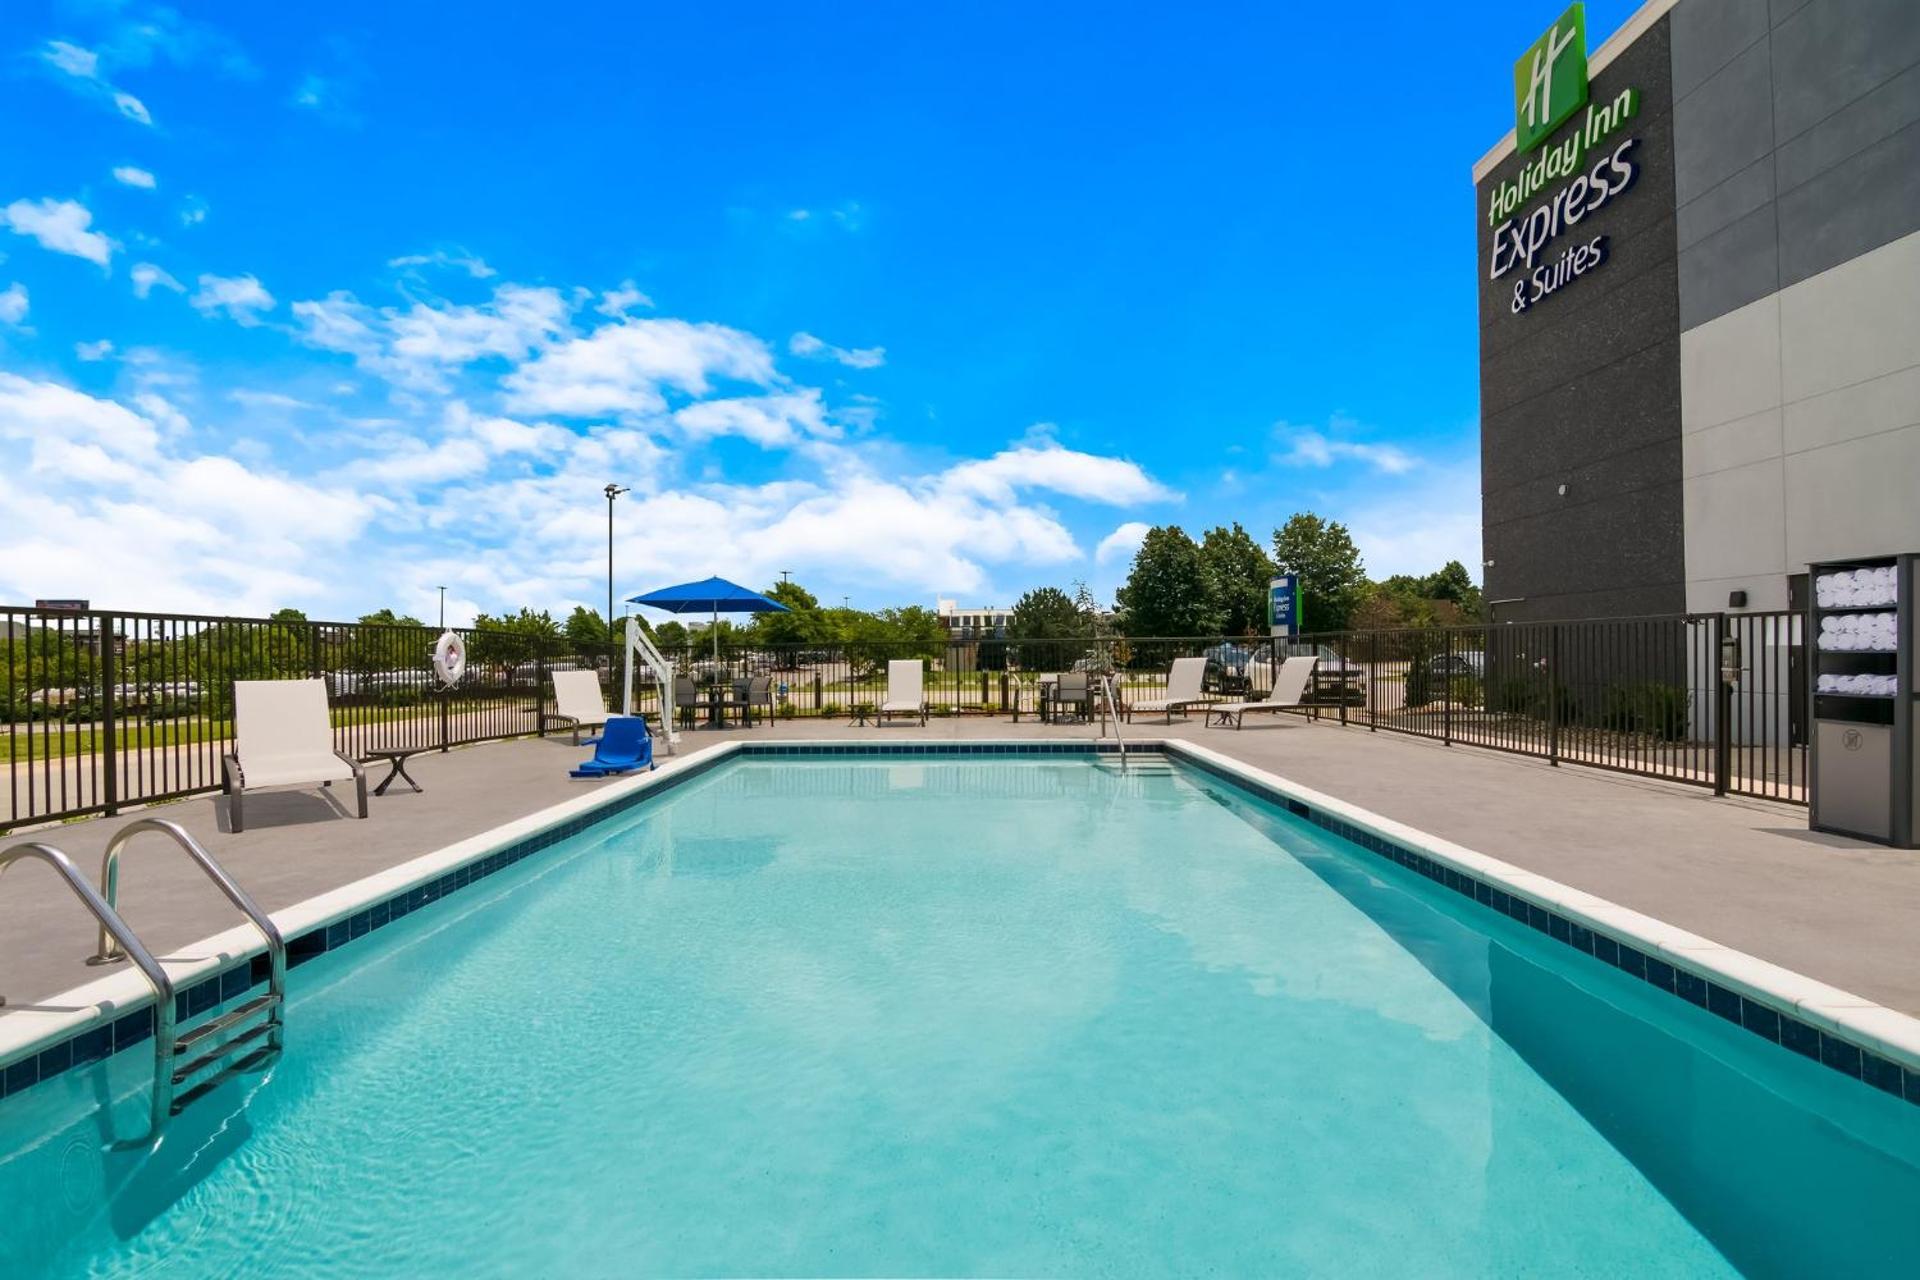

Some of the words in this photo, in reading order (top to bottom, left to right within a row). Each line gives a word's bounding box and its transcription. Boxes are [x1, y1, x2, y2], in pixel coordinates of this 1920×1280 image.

[1488, 131, 1580, 226] Holiday
[1585, 88, 1631, 149] Inn
[1490, 139, 1632, 280] Express
[1511, 279, 1525, 314] &
[1531, 236, 1601, 303] Suites
